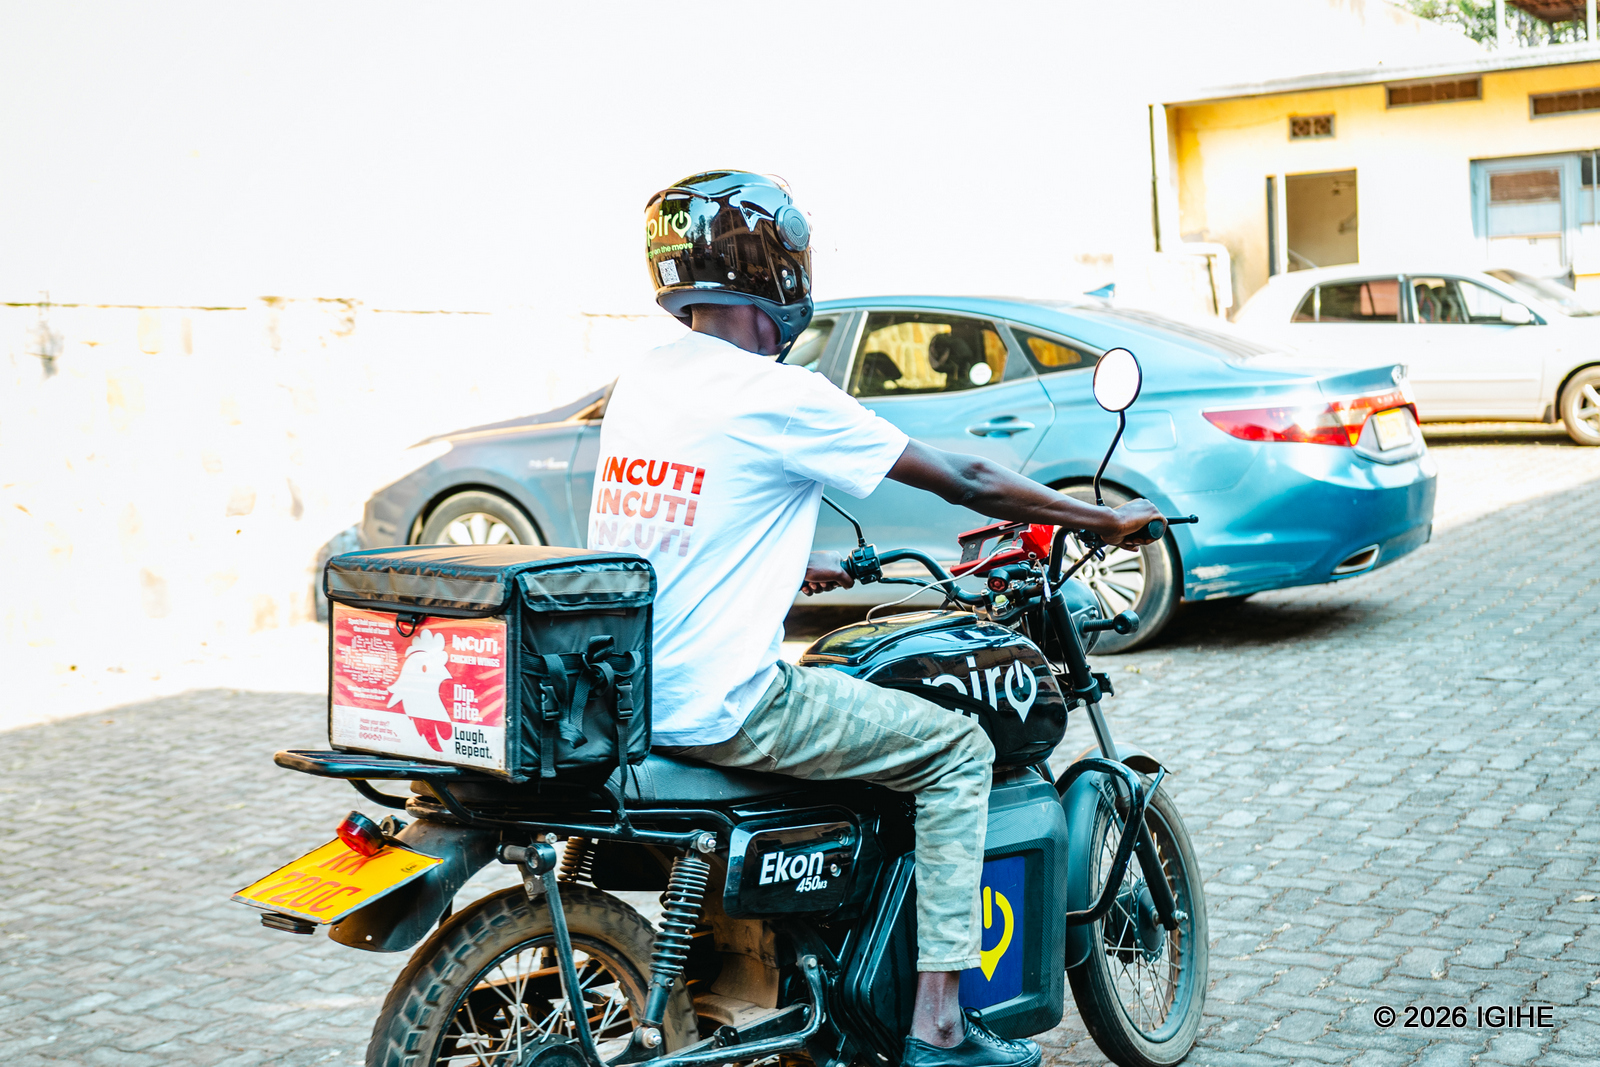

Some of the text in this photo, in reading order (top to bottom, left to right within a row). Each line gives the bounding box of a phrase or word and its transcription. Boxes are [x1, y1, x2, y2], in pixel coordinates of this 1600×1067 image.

[660, 245, 671, 253] the
[672, 242, 694, 251] move
[602, 456, 706, 495] INCUTI
[596, 488, 698, 527] INCUTI
[452, 634, 499, 655] INCUTI
[450, 654, 501, 668] CHICKEN WINGS
[453, 684, 478, 705] Dip.
[453, 702, 483, 722] Bite.
[454, 727, 488, 744] Laugh.
[455, 741, 492, 759] Repeat.
[759, 851, 824, 886] Ekon
[252, 871, 362, 912] 720C
